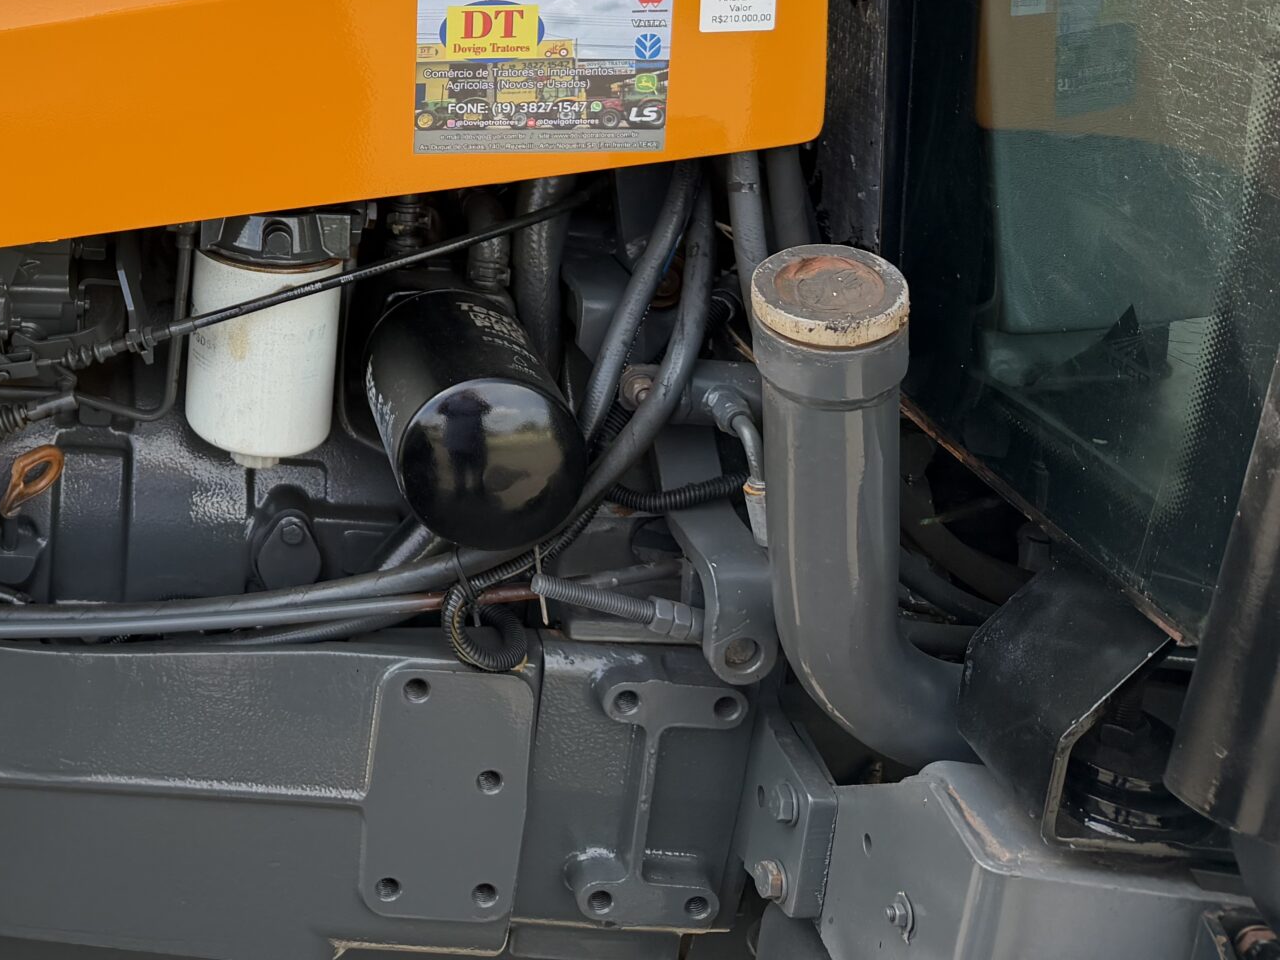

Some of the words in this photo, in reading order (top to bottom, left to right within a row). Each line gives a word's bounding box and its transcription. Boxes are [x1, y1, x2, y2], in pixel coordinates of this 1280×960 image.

[729, 4, 752, 12] Valor
[460, 9, 524, 39] DT
[631, 18, 668, 28] VALTRA
[453, 43, 487, 55] Dovigo
[489, 42, 530, 53] Tratores
[423, 67, 474, 78] Comércio
[476, 68, 489, 78] de
[492, 67, 534, 78] Tratores
[537, 69, 545, 77] e
[547, 67, 614, 78] Implementos
[497, 80, 534, 91] (Novos
[537, 81, 544, 89] e
[547, 79, 590, 90] Usados)
[447, 103, 489, 114] FONE:
[492, 102, 516, 116] (19)
[519, 101, 587, 113] 3827-1547
[629, 107, 659, 122] LS
